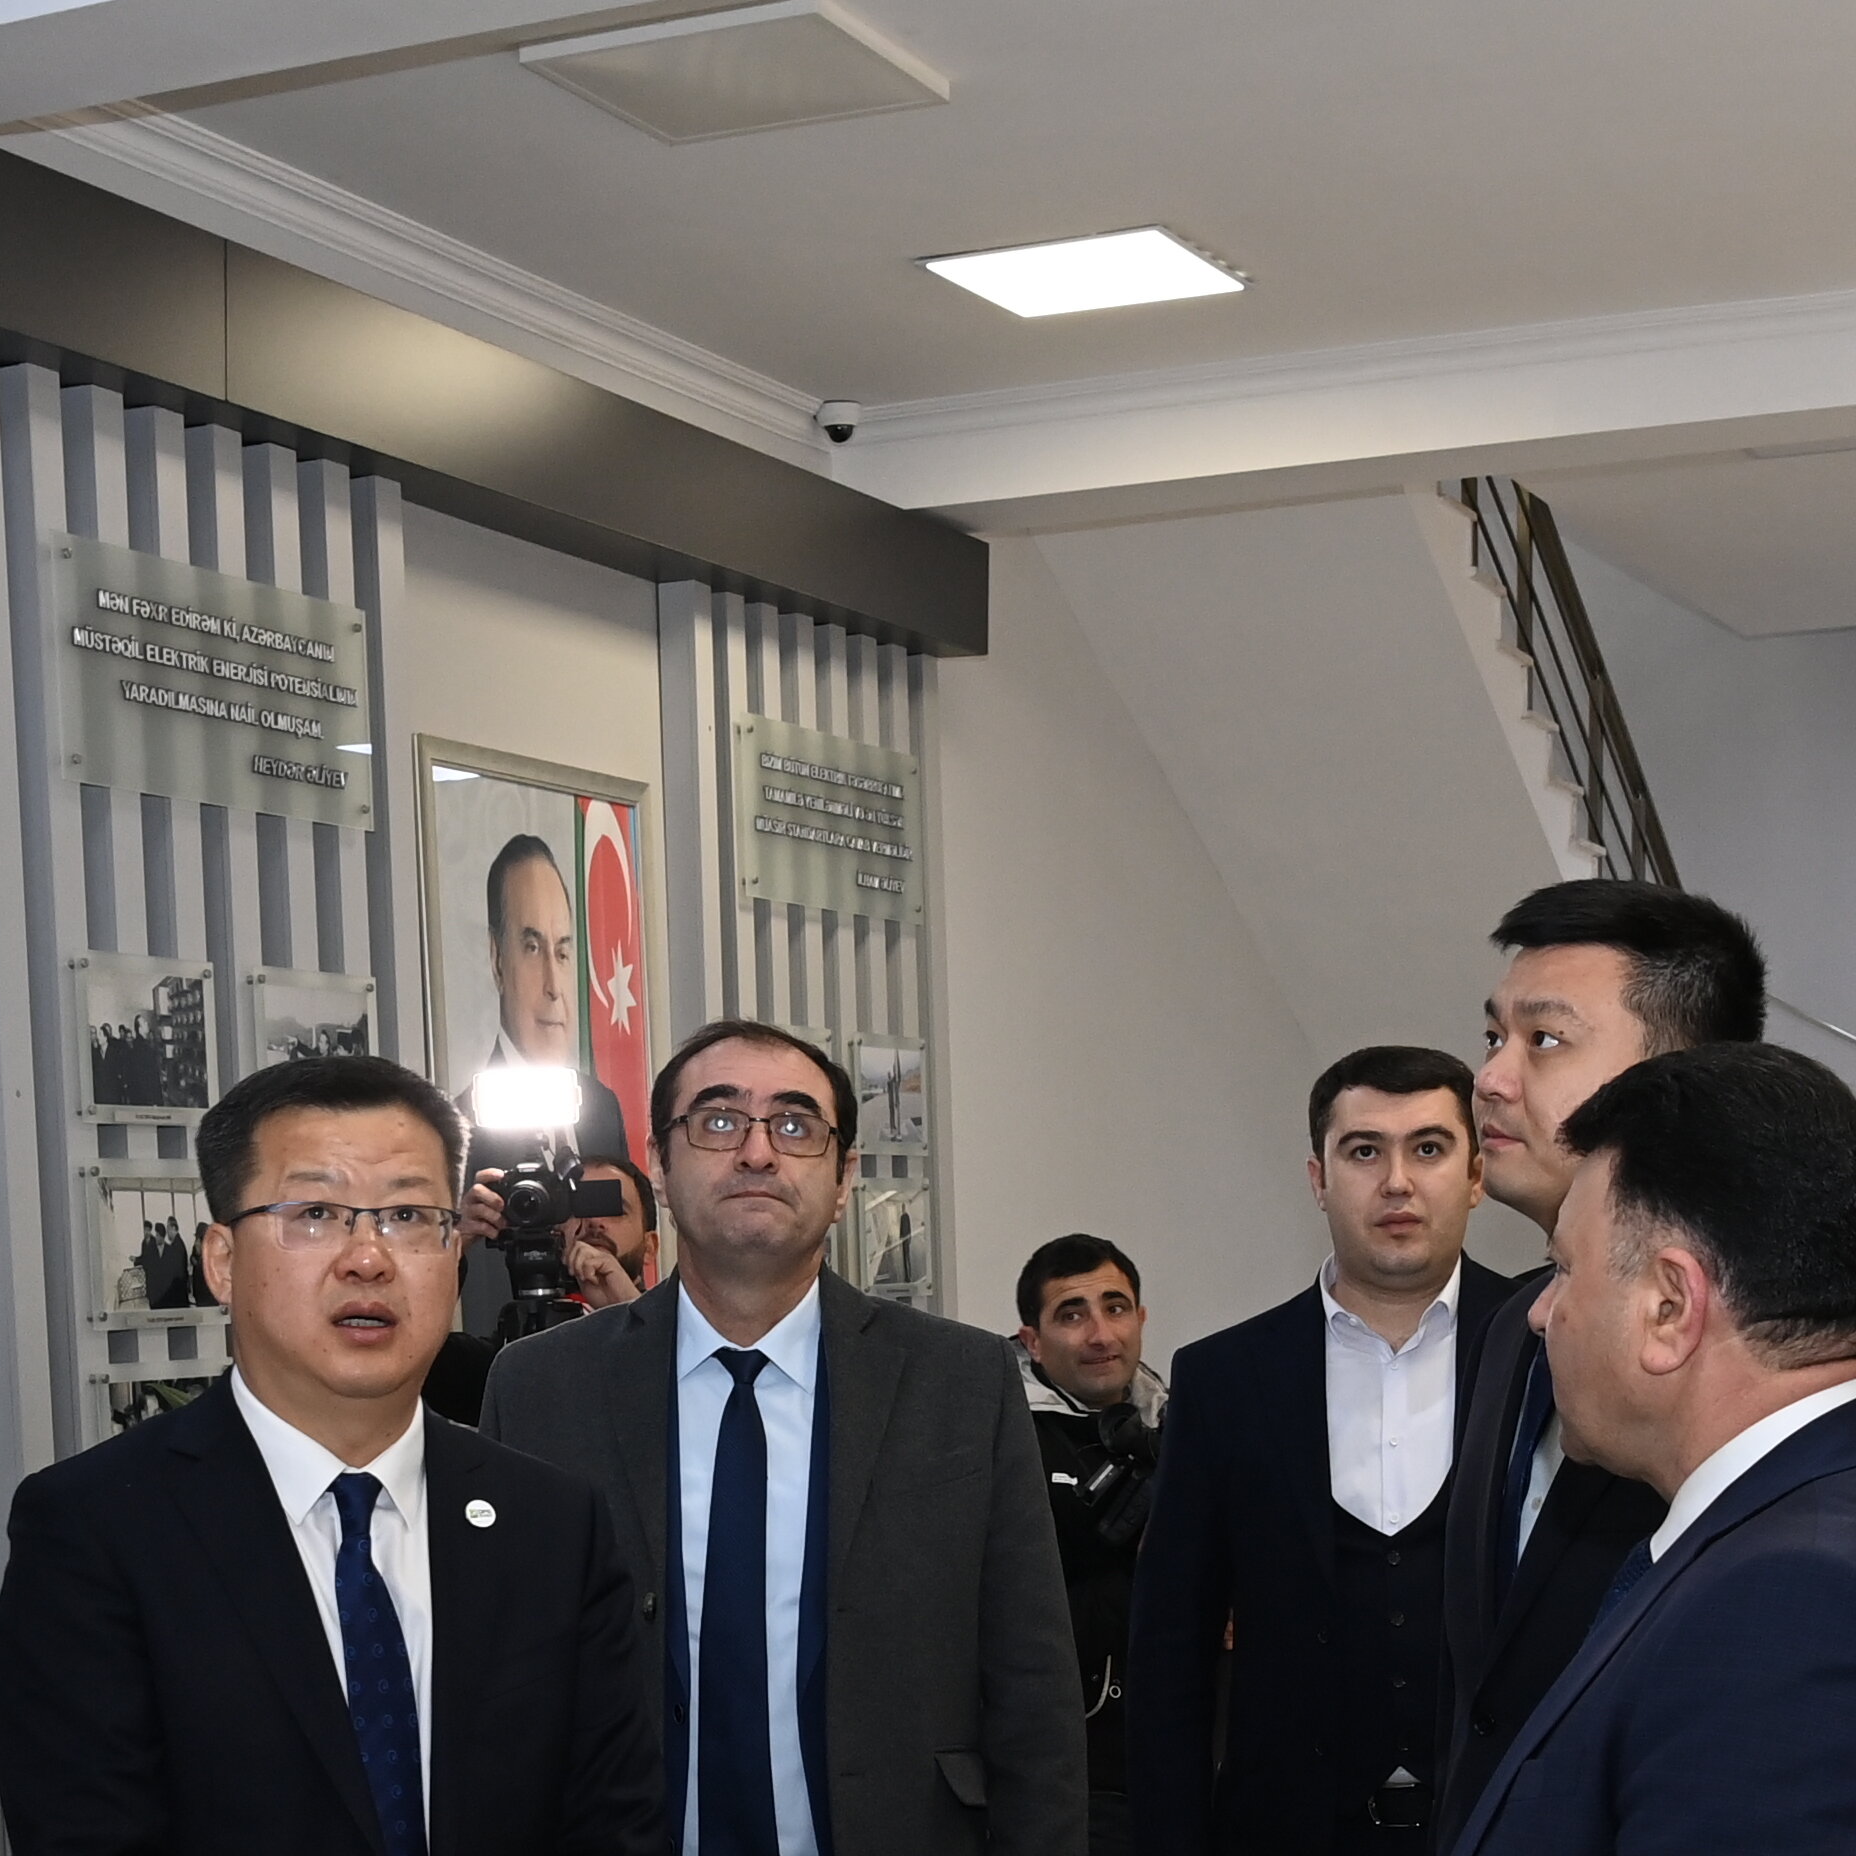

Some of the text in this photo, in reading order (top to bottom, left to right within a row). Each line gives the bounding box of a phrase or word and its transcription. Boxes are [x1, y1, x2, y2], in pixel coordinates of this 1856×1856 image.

[97, 588, 129, 614] MƏN
[131, 597, 169, 623] FƏXR
[170, 606, 221, 636] EDİRƏM
[71, 625, 144, 660] MÜSTƏQİL
[145, 644, 210, 675] ELEKTRİK
[211, 658, 269, 687] ENERJİSİ
[120, 680, 229, 720] YARADILMASINA
[229, 701, 259, 726] NAİL
[253, 755, 348, 790] HEYDƏR ƏLİYEV
